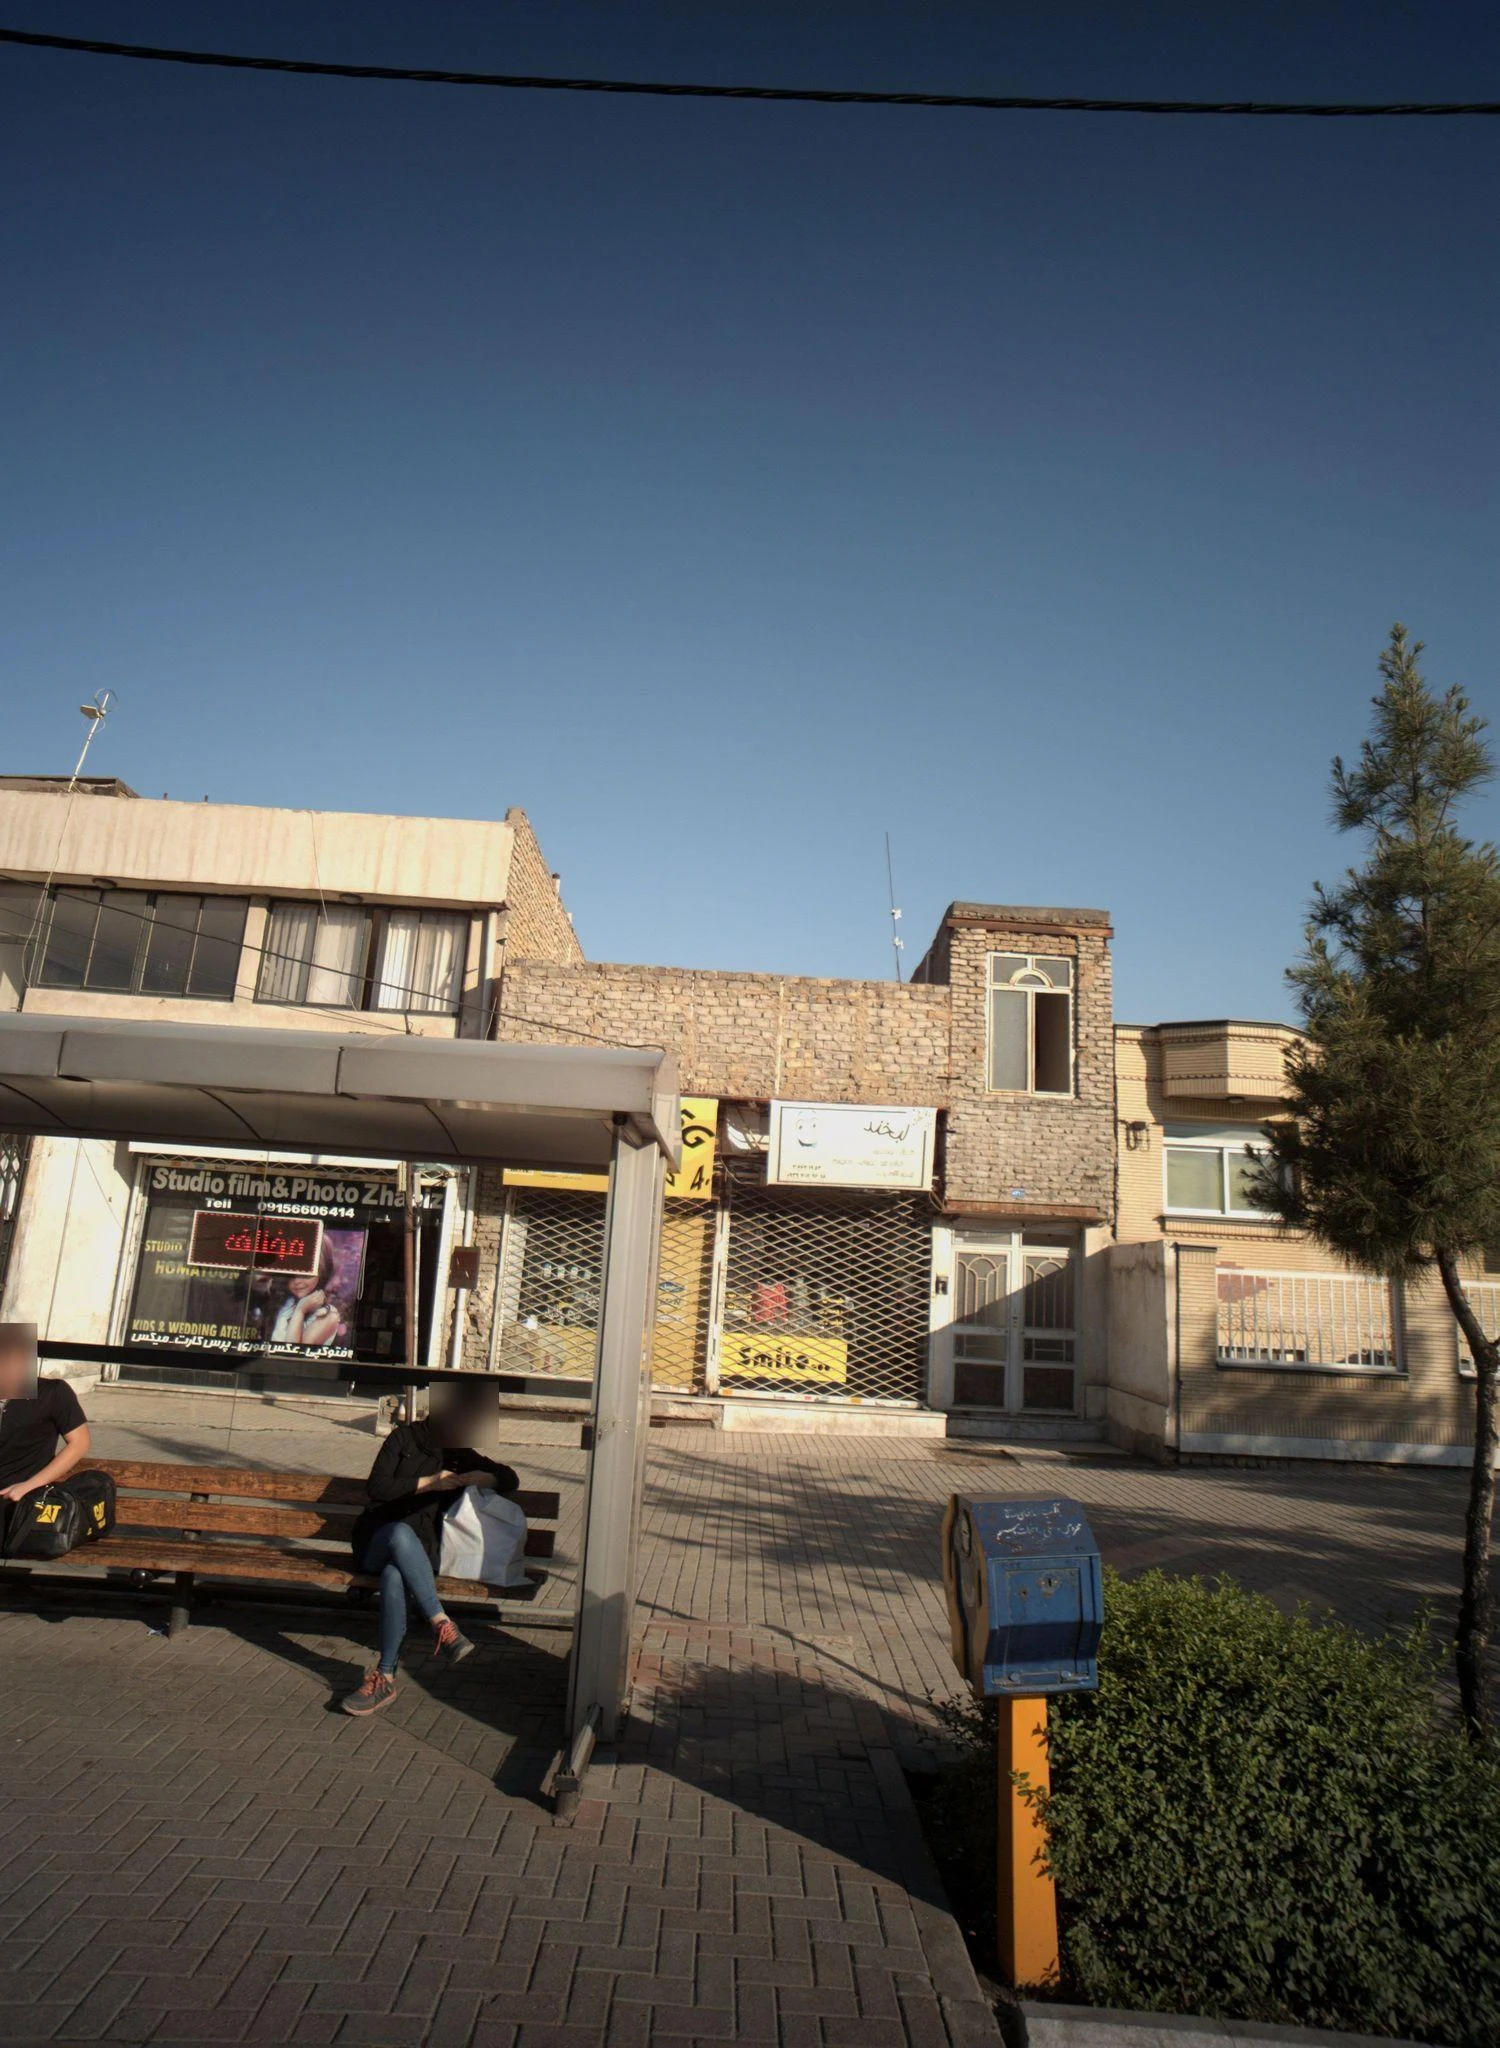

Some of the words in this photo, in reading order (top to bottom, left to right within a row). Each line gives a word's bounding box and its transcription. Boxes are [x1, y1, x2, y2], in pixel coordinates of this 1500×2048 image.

[864, 1121, 910, 1144] لبخند
[152, 1167, 225, 1194] Studio
[257, 1201, 355, 1218] 09156606414
[145, 1239, 183, 1254] STUDIO
[132, 1319, 155, 1332] KIDS
[158, 1321, 166, 1333] &
[168, 1321, 218, 1336] WEDDING
[220, 1325, 258, 1340] ATELIER
